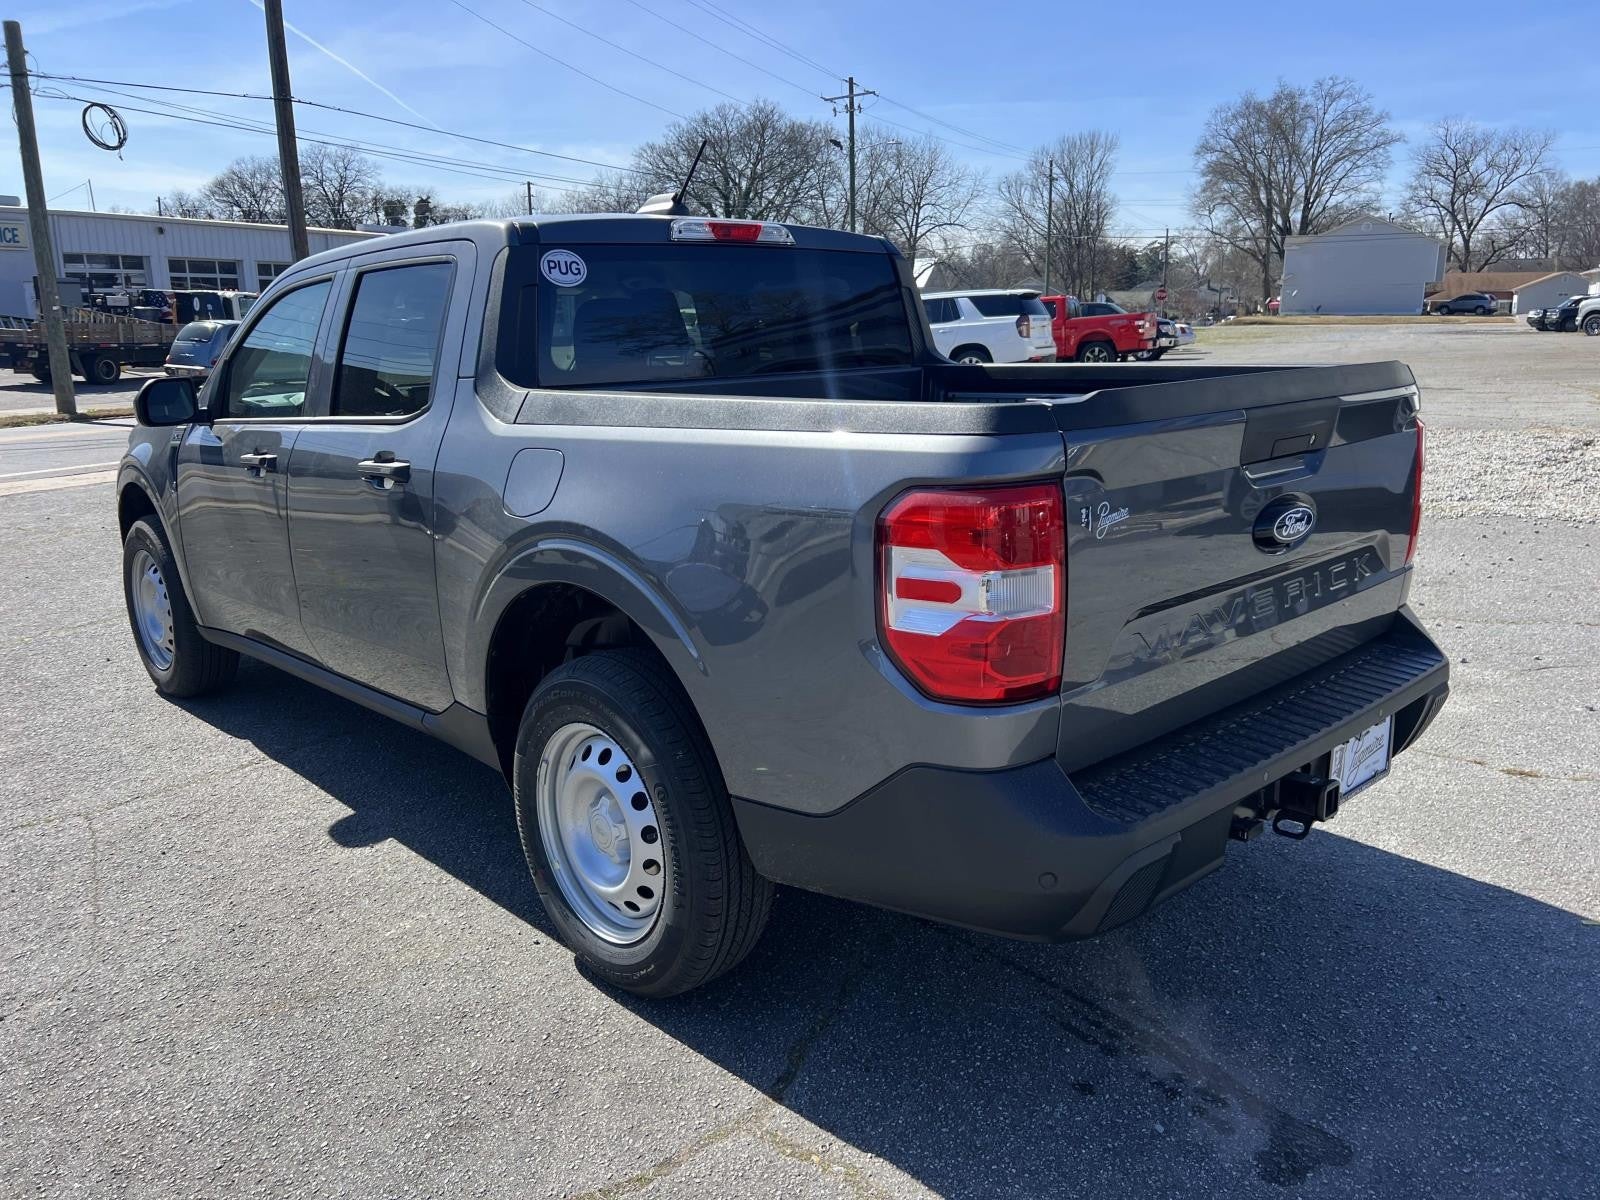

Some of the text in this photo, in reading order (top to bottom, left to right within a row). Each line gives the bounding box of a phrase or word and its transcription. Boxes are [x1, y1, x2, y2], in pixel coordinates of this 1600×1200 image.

[547, 259, 582, 276] PUG
[1281, 512, 1308, 536] Ford
[1121, 552, 1372, 660] MAVERICK
